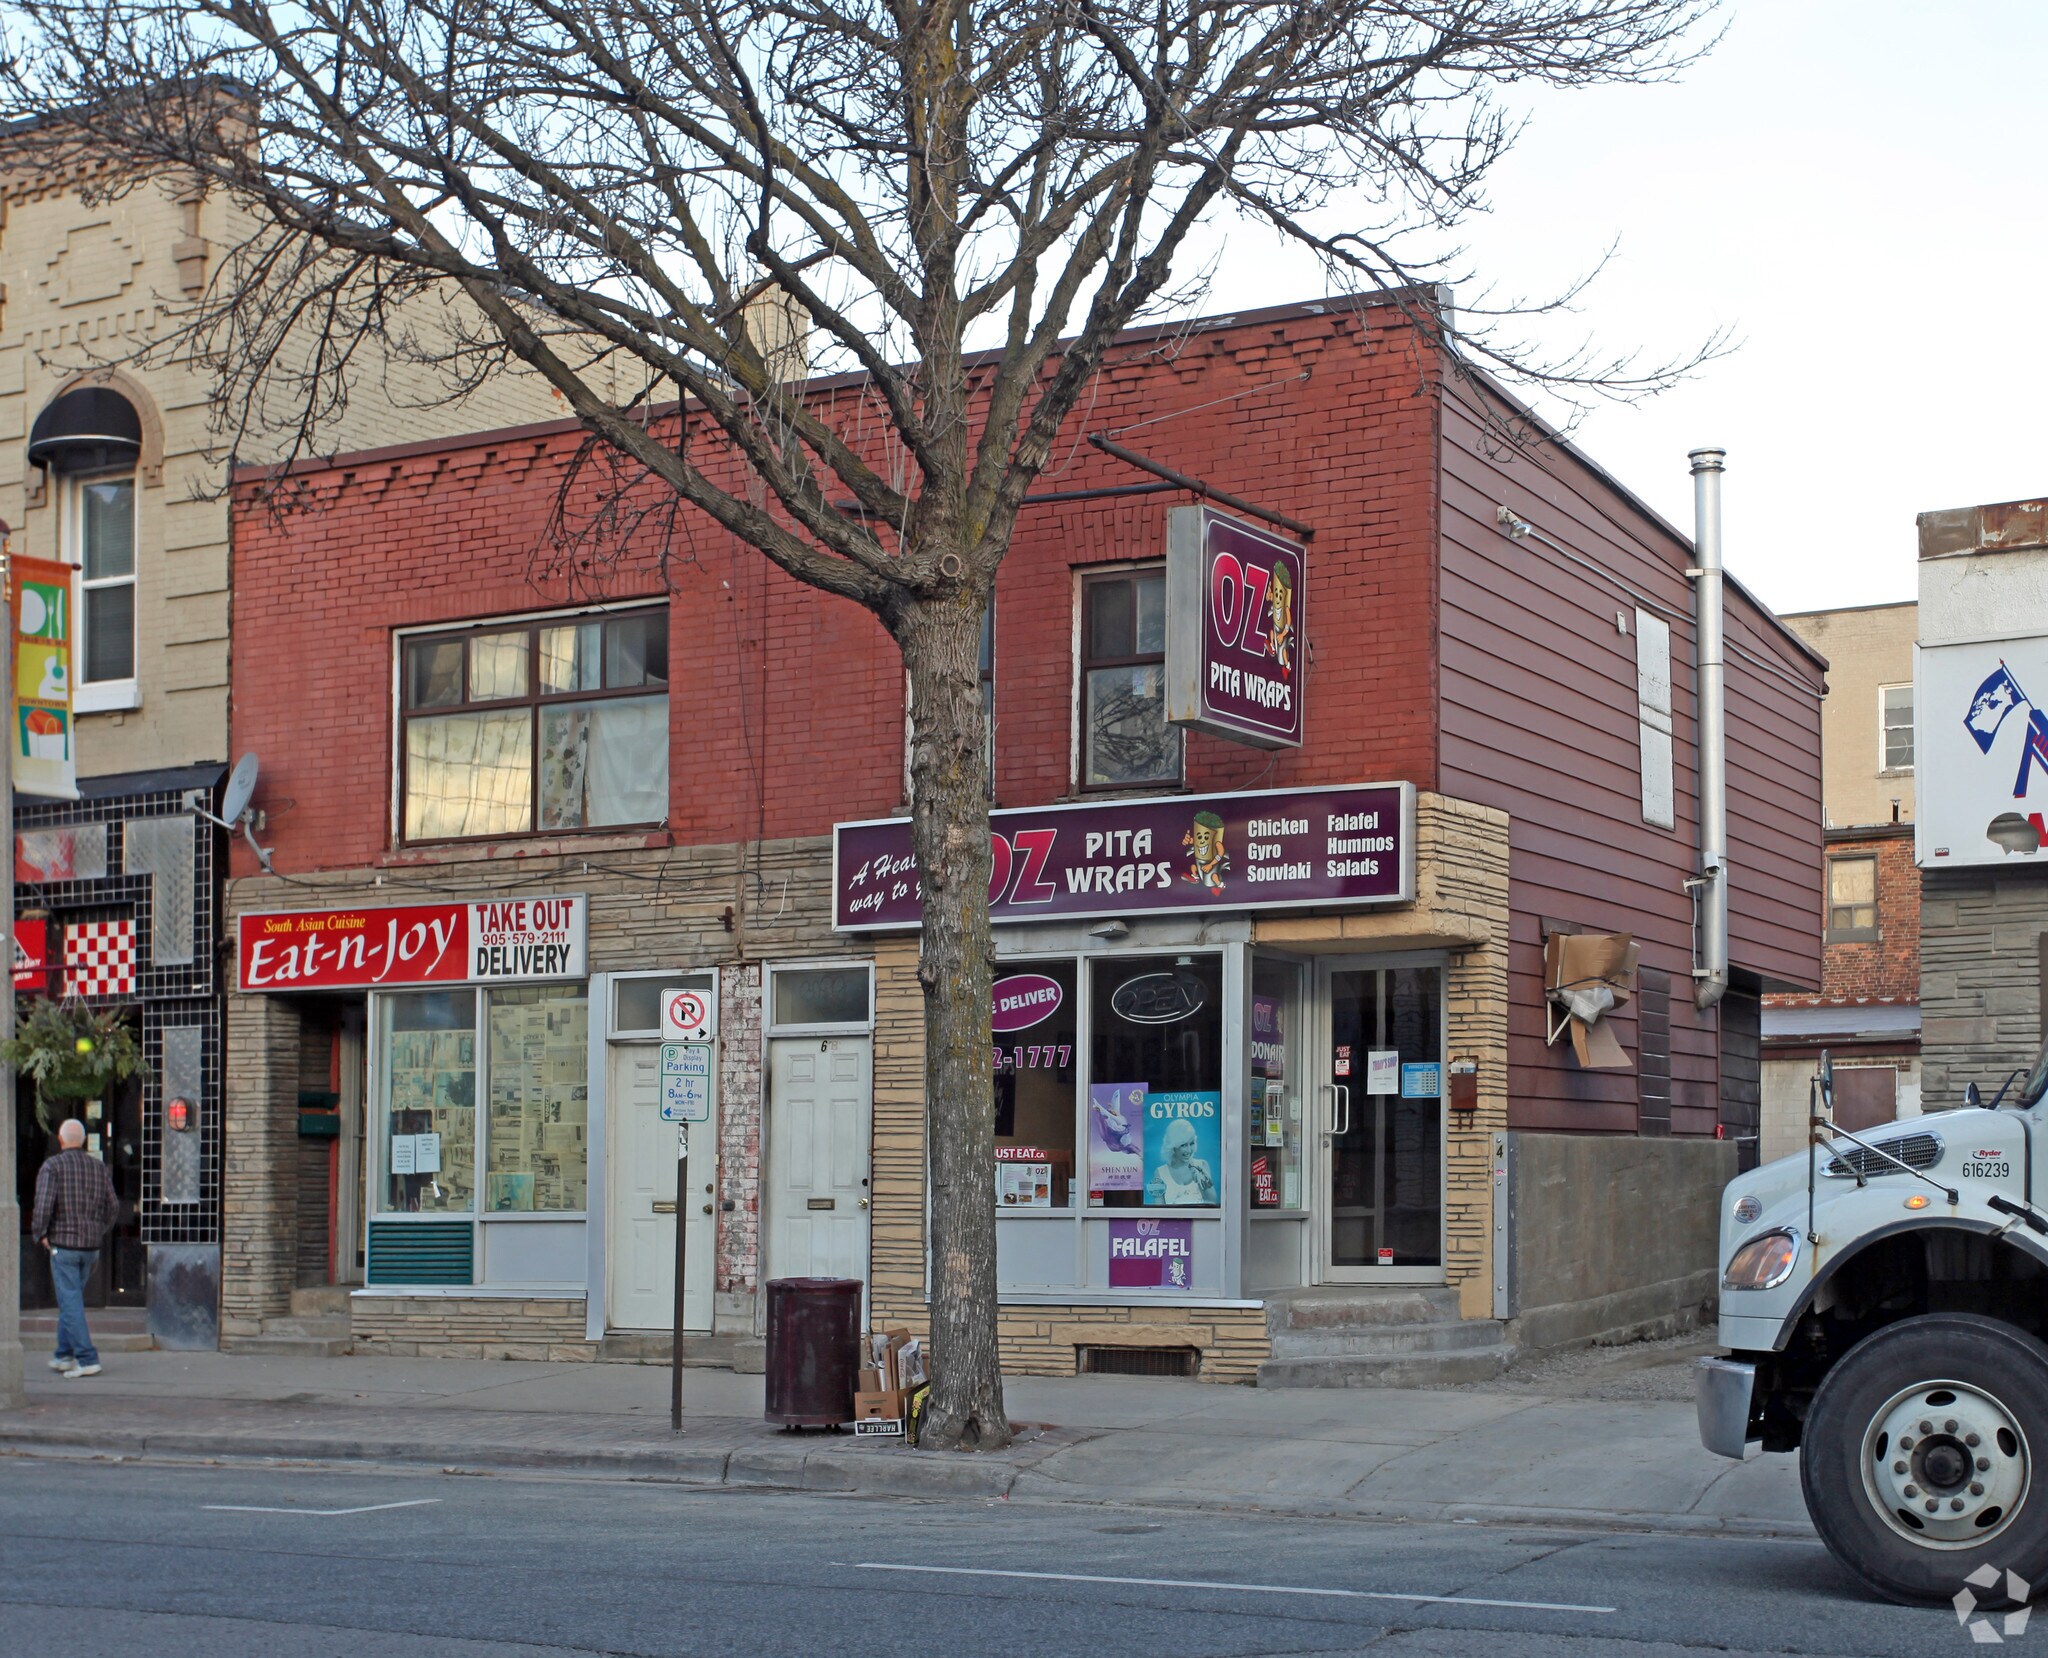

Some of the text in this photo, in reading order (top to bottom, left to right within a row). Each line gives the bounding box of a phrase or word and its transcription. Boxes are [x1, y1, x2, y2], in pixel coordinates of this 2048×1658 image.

[1211, 552, 1270, 657] OZ
[1210, 660, 1292, 711] PITA WRAPS
[1247, 818, 1309, 838] Chicken
[1327, 811, 1379, 832] Falafel
[1085, 828, 1153, 859] PITA
[1247, 842, 1282, 861] Gyro
[1327, 836, 1394, 855] Hummos
[848, 852, 918, 891] A Heal
[1065, 861, 1172, 895] WRAPS
[1247, 861, 1312, 882] Souvlaki
[1326, 857, 1379, 878] Salads
[849, 891, 884, 913] way
[891, 880, 908, 900] to
[264, 915, 366, 933] South Asian Cuisine
[476, 899, 573, 933] TAKE OUT
[247, 912, 457, 985] Eat-n-Joy
[476, 943, 571, 976] DELIVERY
[1000, 986, 1057, 1013] DELIVER
[1254, 1002, 1272, 1032] OZ
[992, 1044, 1071, 1069] 2-1777
[1252, 1040, 1285, 1063] DONAIR
[666, 1061, 705, 1074] Parking
[676, 1077, 695, 1088] 2 hr
[1163, 1093, 1199, 1102] OLYMPIA
[1150, 1101, 1214, 1119] GYROS
[994, 1148, 1015, 1159] UST
[1979, 1149, 2002, 1157] Ryder
[1122, 1165, 1138, 1173] YUN
[1962, 1162, 2010, 1178] 616239
[1256, 1174, 1271, 1187] JUST
[1136, 1218, 1160, 1236] OZ
[1112, 1237, 1190, 1258] FALAFEL
